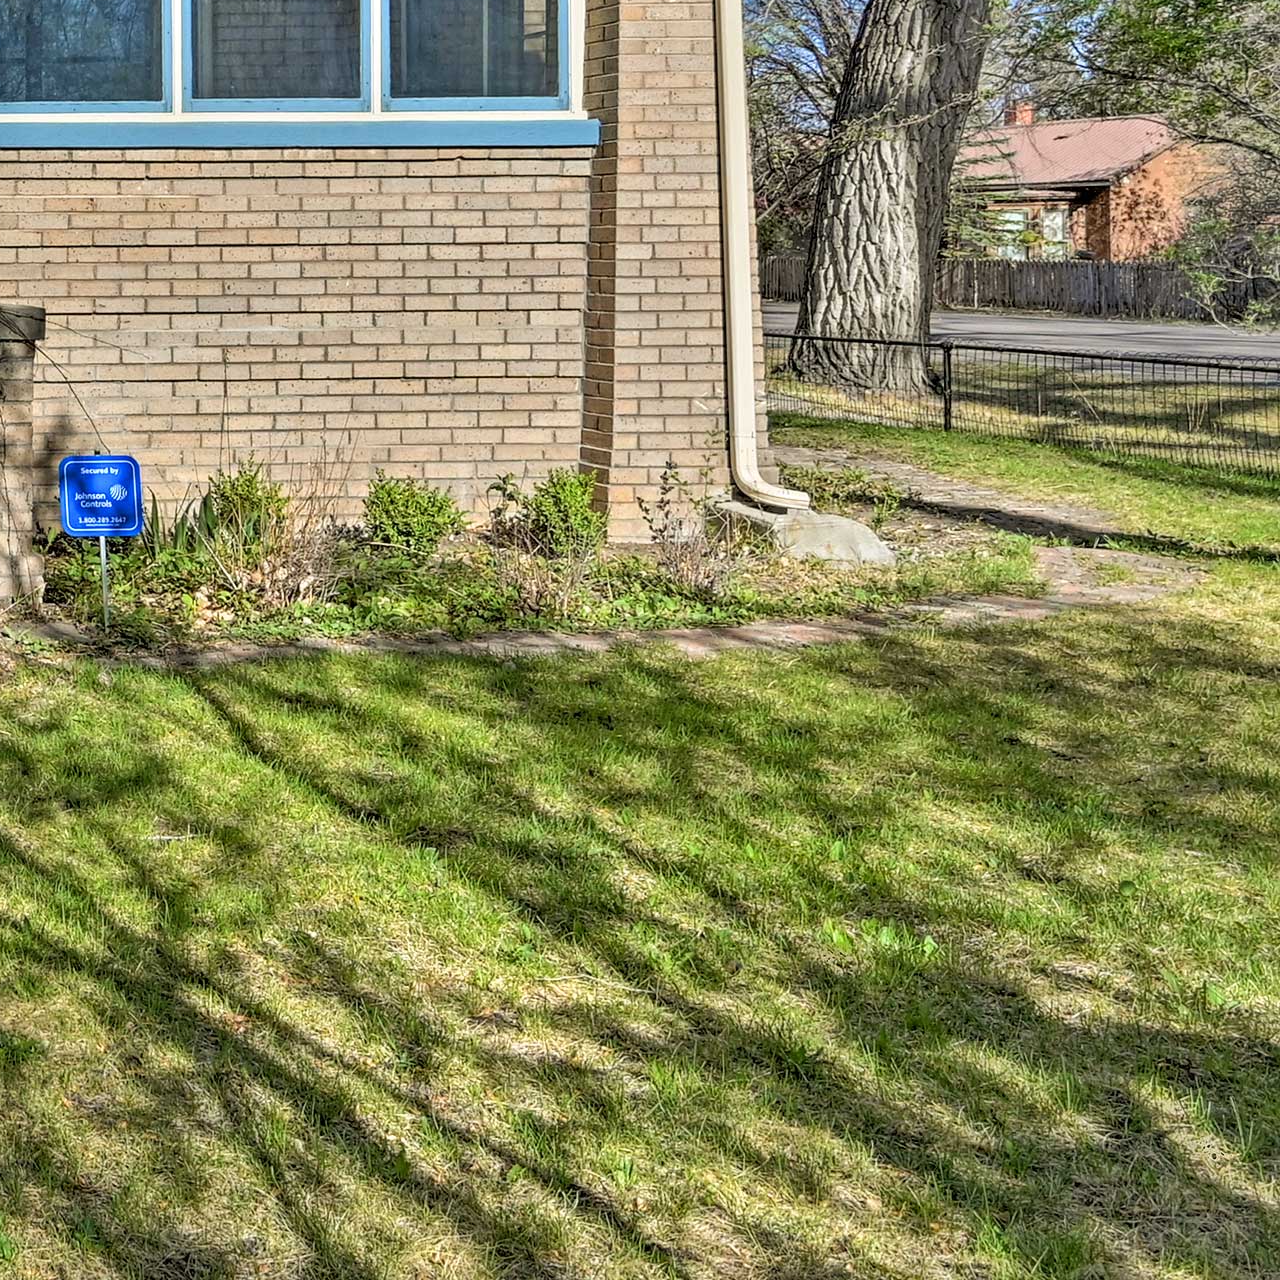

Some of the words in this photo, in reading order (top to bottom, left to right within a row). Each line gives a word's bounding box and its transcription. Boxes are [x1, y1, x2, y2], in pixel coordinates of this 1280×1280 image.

[80, 467, 109, 475] Secured
[109, 467, 119, 476] by
[74, 492, 106, 501] Johnson
[80, 500, 113, 508] Controls
